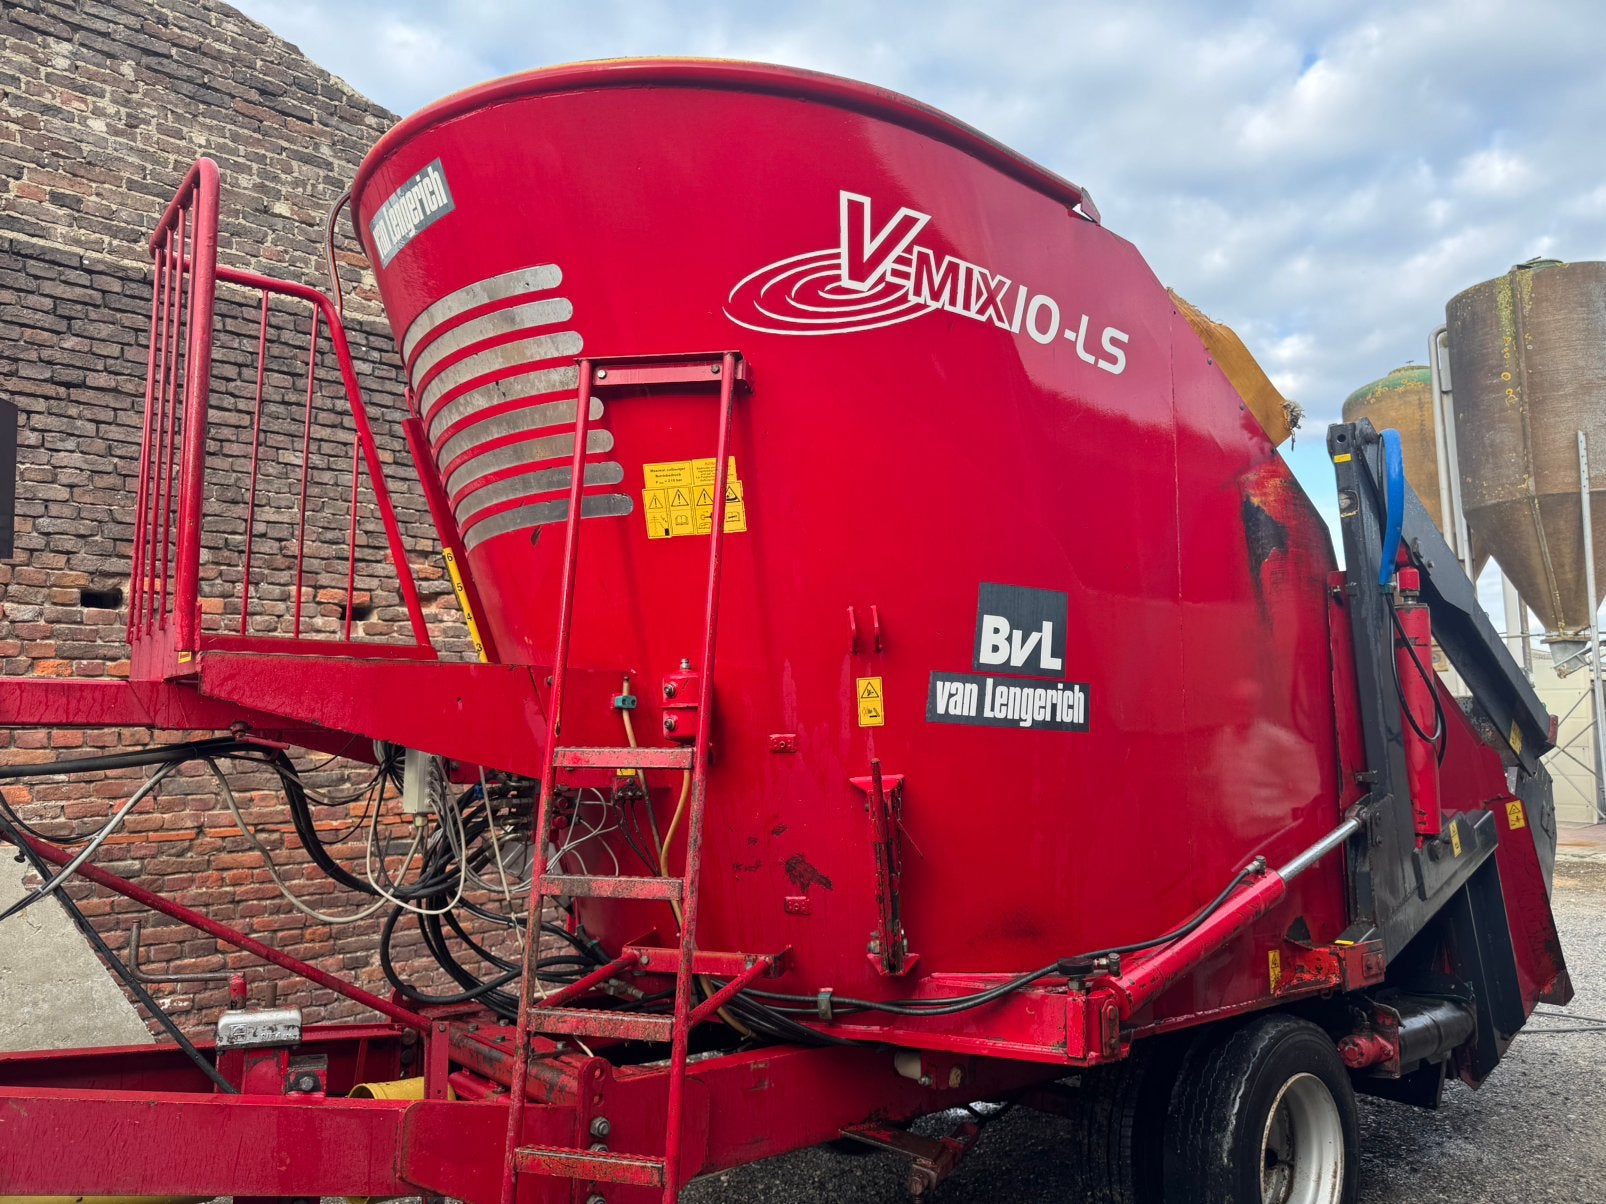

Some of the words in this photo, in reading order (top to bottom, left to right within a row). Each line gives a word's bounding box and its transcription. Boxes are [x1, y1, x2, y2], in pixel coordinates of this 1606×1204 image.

[383, 166, 448, 246] Lengerich
[446, 553, 453, 562] 6
[456, 582, 463, 592] 5
[466, 613, 472, 621] 4
[476, 643, 483, 652] 3
[979, 614, 1062, 671] BvL
[936, 680, 978, 717] van
[983, 677, 1085, 728] Lengerich
